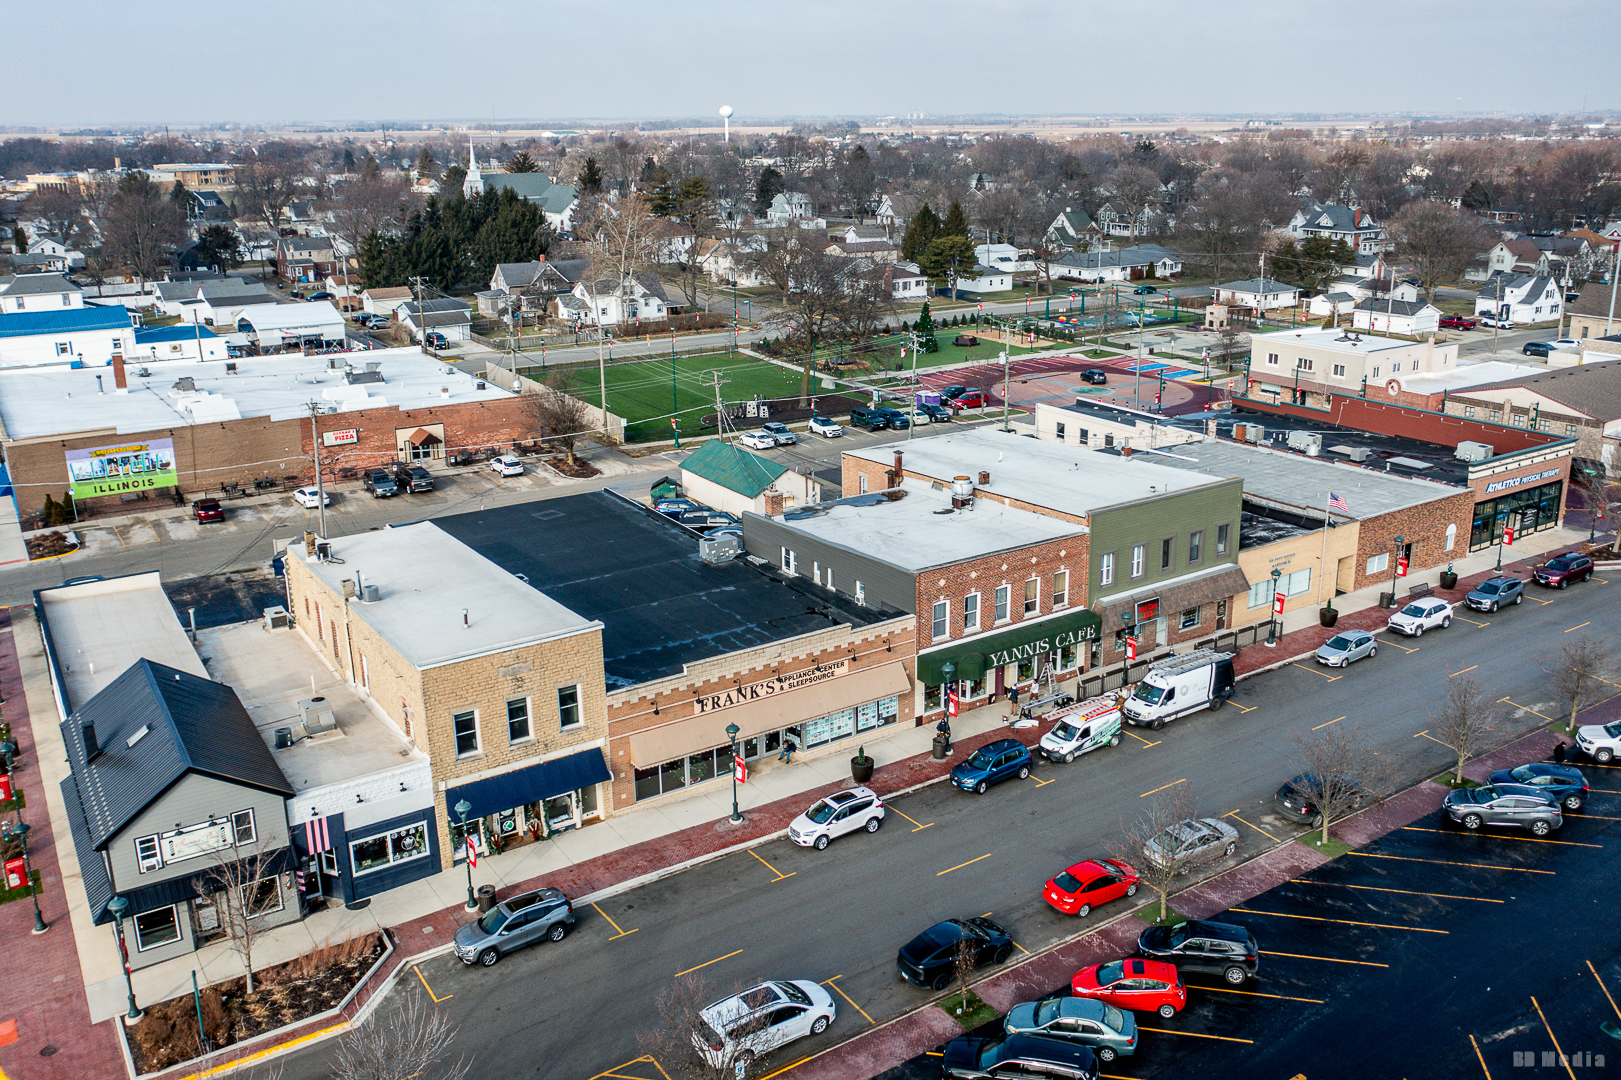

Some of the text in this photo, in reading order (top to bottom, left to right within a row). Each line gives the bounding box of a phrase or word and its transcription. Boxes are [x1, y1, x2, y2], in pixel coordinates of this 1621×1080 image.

[94, 478, 155, 493] ILLINOIS
[1485, 477, 1520, 494] ATHLETICO
[1521, 473, 1540, 484] PHYSICAL
[989, 637, 1050, 667] YANNIS
[780, 661, 845, 684] APPLIANCE CENTER
[788, 670, 836, 689] SLEEPSOURCE
[699, 680, 775, 713] FRANK'S
